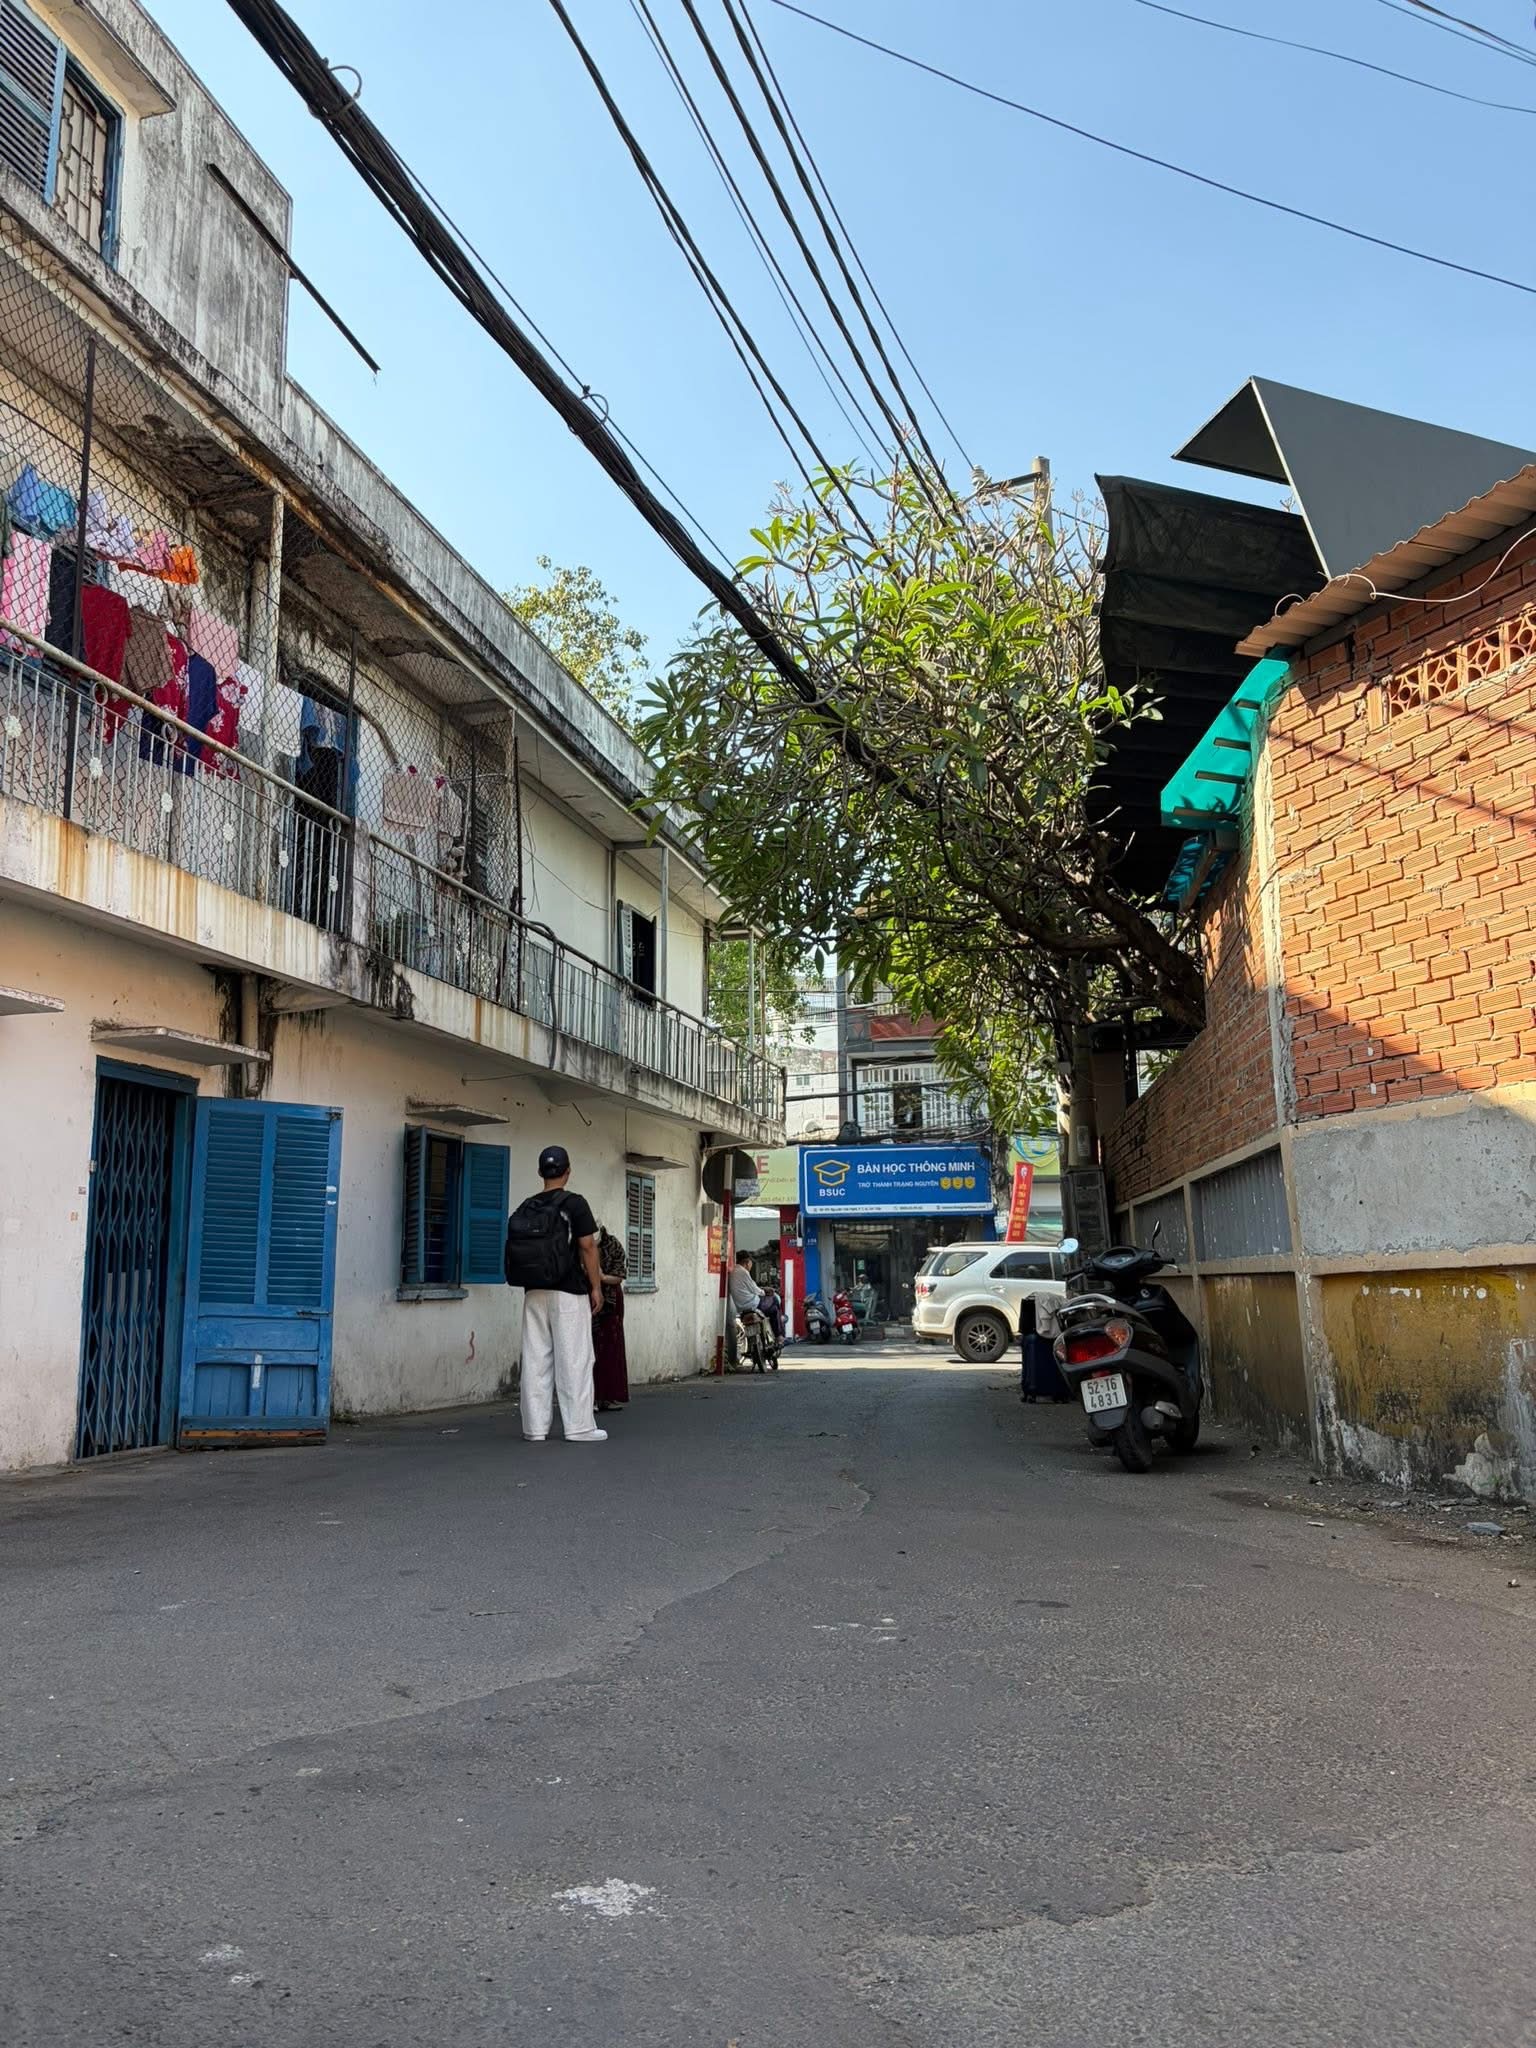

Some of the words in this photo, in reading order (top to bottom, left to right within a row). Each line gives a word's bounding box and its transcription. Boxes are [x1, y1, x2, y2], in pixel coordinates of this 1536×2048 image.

[754, 1155, 770, 1174] E
[857, 1161, 880, 1174] BÀN
[882, 1162, 906, 1176] HỌC
[908, 1160, 947, 1173] THÔNG
[948, 1161, 976, 1172] MINH
[819, 1188, 846, 1197] BSUC
[1087, 1377, 1117, 1395] 52-T6
[1091, 1391, 1119, 1409] 4831
